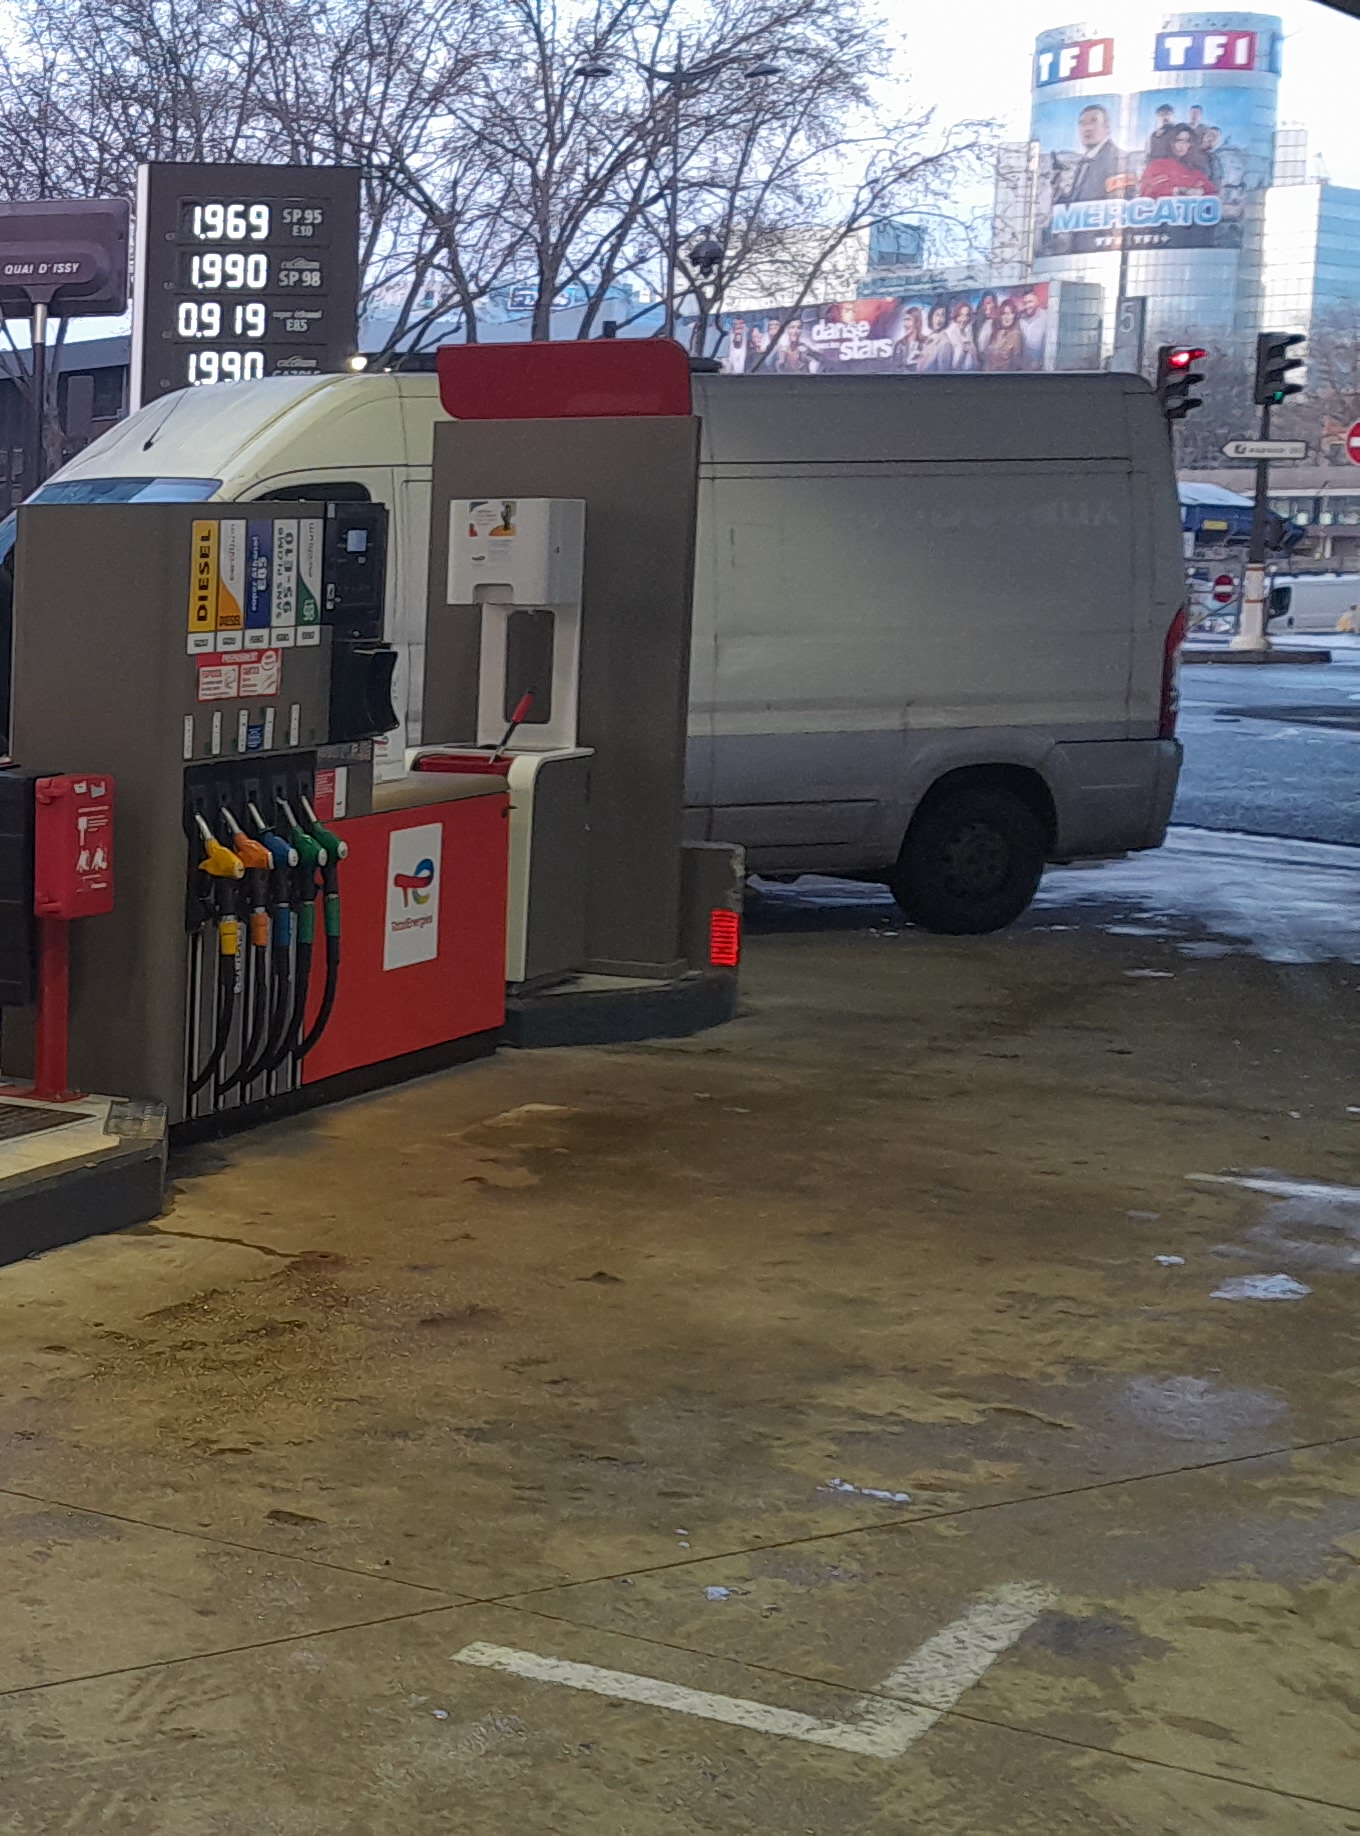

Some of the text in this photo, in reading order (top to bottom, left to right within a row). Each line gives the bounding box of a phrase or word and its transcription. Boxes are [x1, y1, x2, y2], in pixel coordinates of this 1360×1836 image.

[1039, 43, 1106, 82] TF1
[1164, 35, 1251, 66] TF1
[1052, 196, 1222, 233] MERCATO
[4, 263, 34, 275] QUAI
[812, 319, 871, 341] danse
[839, 338, 894, 360] stars
[197, 529, 211, 621] DIESEL
